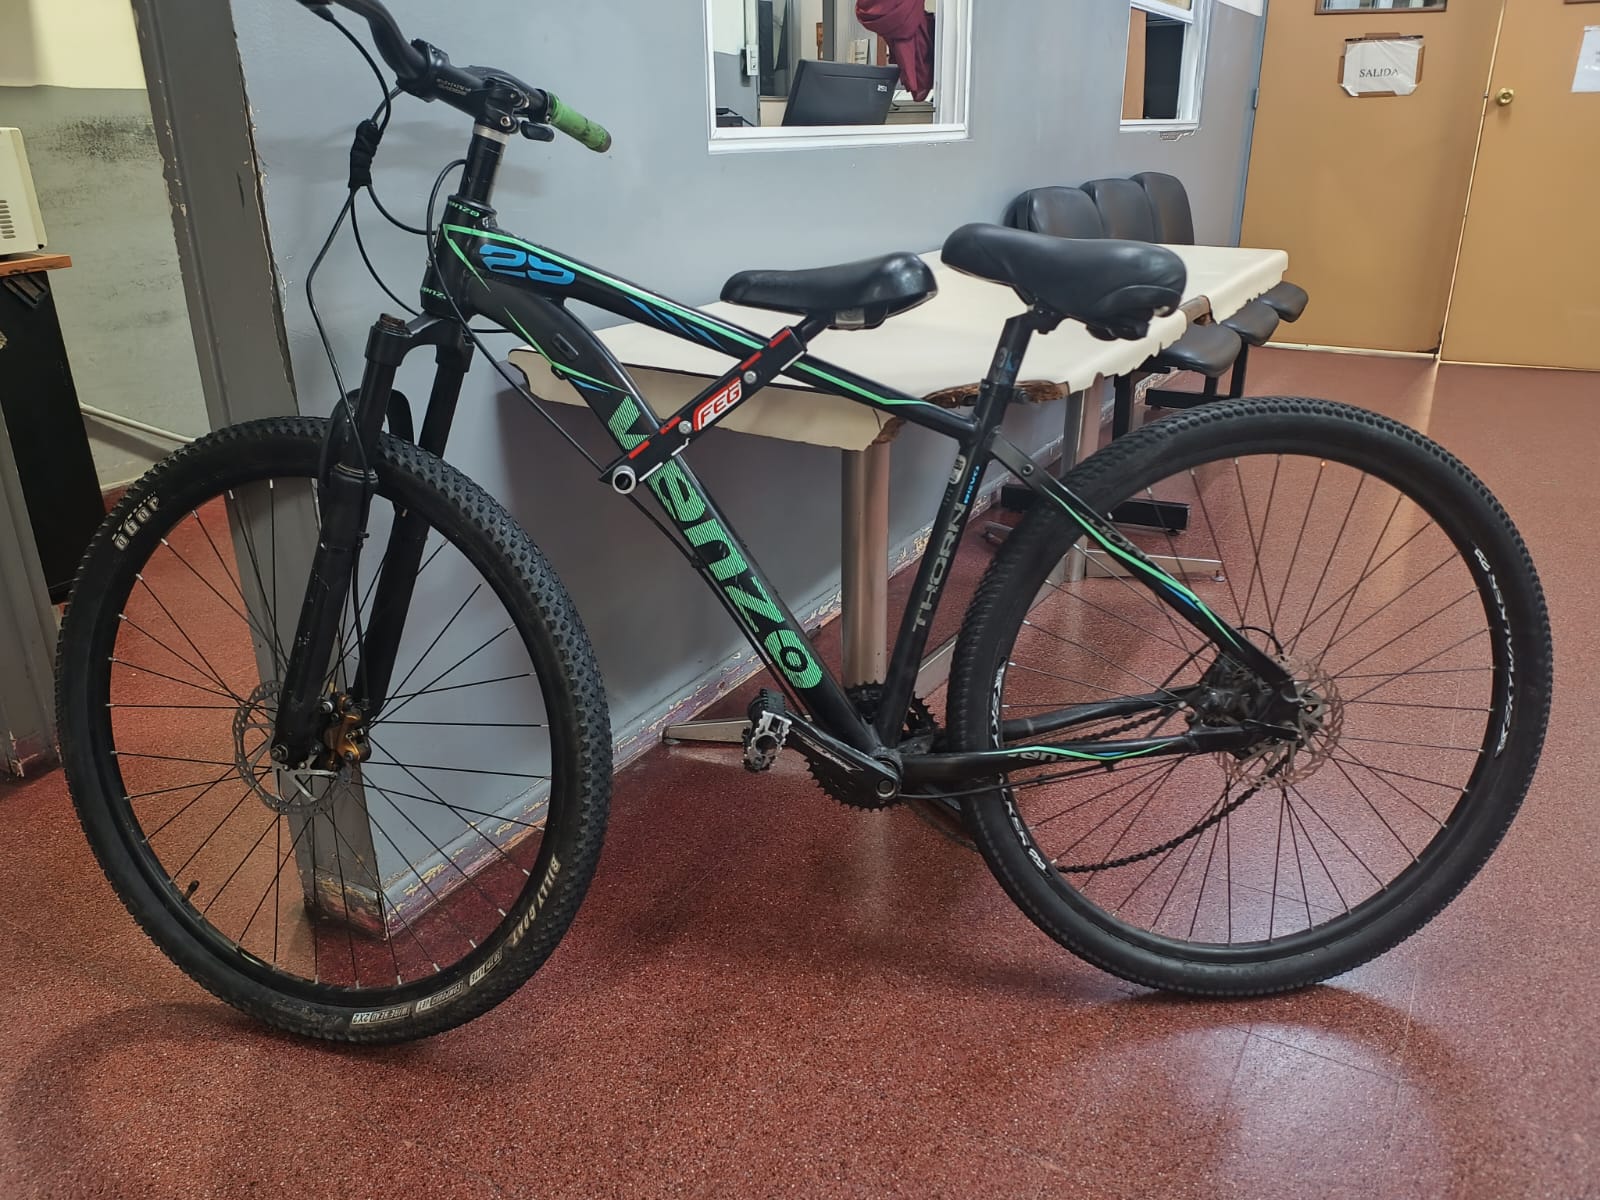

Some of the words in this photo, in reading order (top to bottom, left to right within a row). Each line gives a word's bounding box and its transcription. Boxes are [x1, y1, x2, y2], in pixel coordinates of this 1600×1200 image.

[1359, 67, 1399, 79] SALIDA
[479, 243, 576, 285] 29
[700, 380, 742, 429] FEG
[911, 502, 968, 633] THORN
[1488, 573, 1515, 726] SKYWALKER
[990, 694, 1031, 847] SKYALKER
[536, 854, 562, 909] BILLY
[510, 903, 536, 945] GOAT
